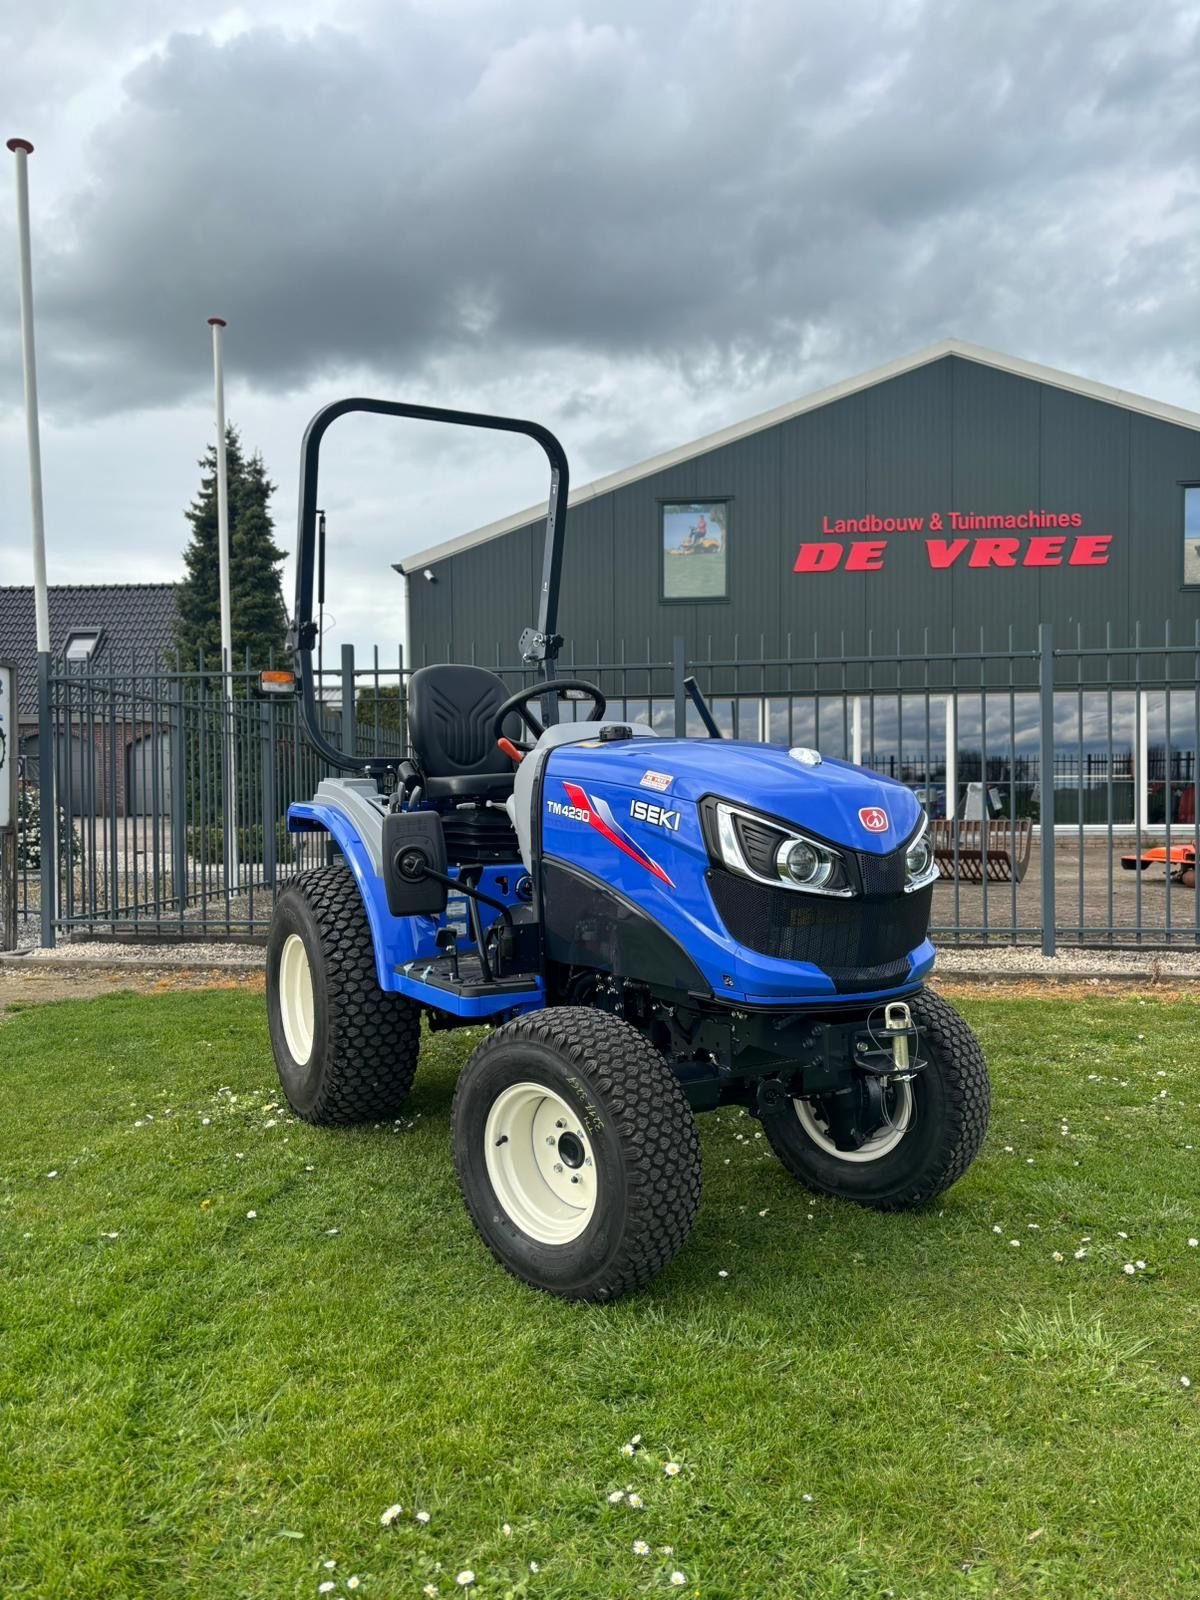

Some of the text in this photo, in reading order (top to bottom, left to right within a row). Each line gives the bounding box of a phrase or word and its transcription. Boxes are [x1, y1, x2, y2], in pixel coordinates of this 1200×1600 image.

[823, 510, 1083, 534] Landbouw & Tuinmachines
[793, 535, 1113, 573] DE VREE
[547, 801, 590, 823] TM4230
[630, 800, 681, 831] ISEKI
